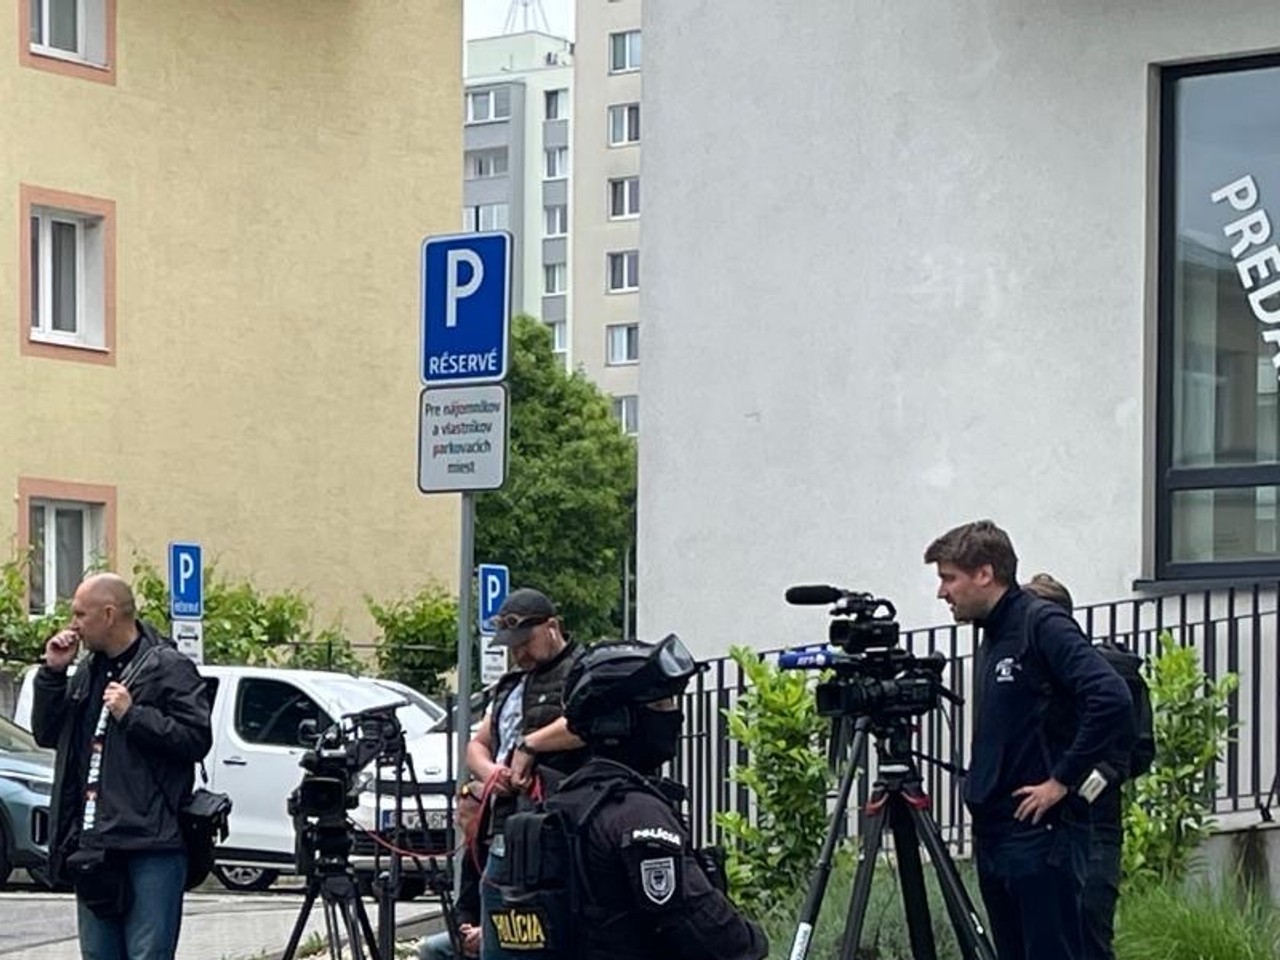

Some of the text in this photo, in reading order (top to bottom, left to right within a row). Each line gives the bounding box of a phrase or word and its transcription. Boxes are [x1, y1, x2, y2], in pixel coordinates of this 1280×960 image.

[446, 249, 484, 327] P
[429, 350, 498, 375] RÉSERVÉ
[425, 403, 440, 416] Pre
[432, 424, 439, 436] a
[447, 461, 475, 474] miest
[179, 552, 194, 593] P
[487, 574, 500, 612] P
[633, 827, 681, 846] POLÍCIA
[492, 909, 546, 942] POLÍCIA
